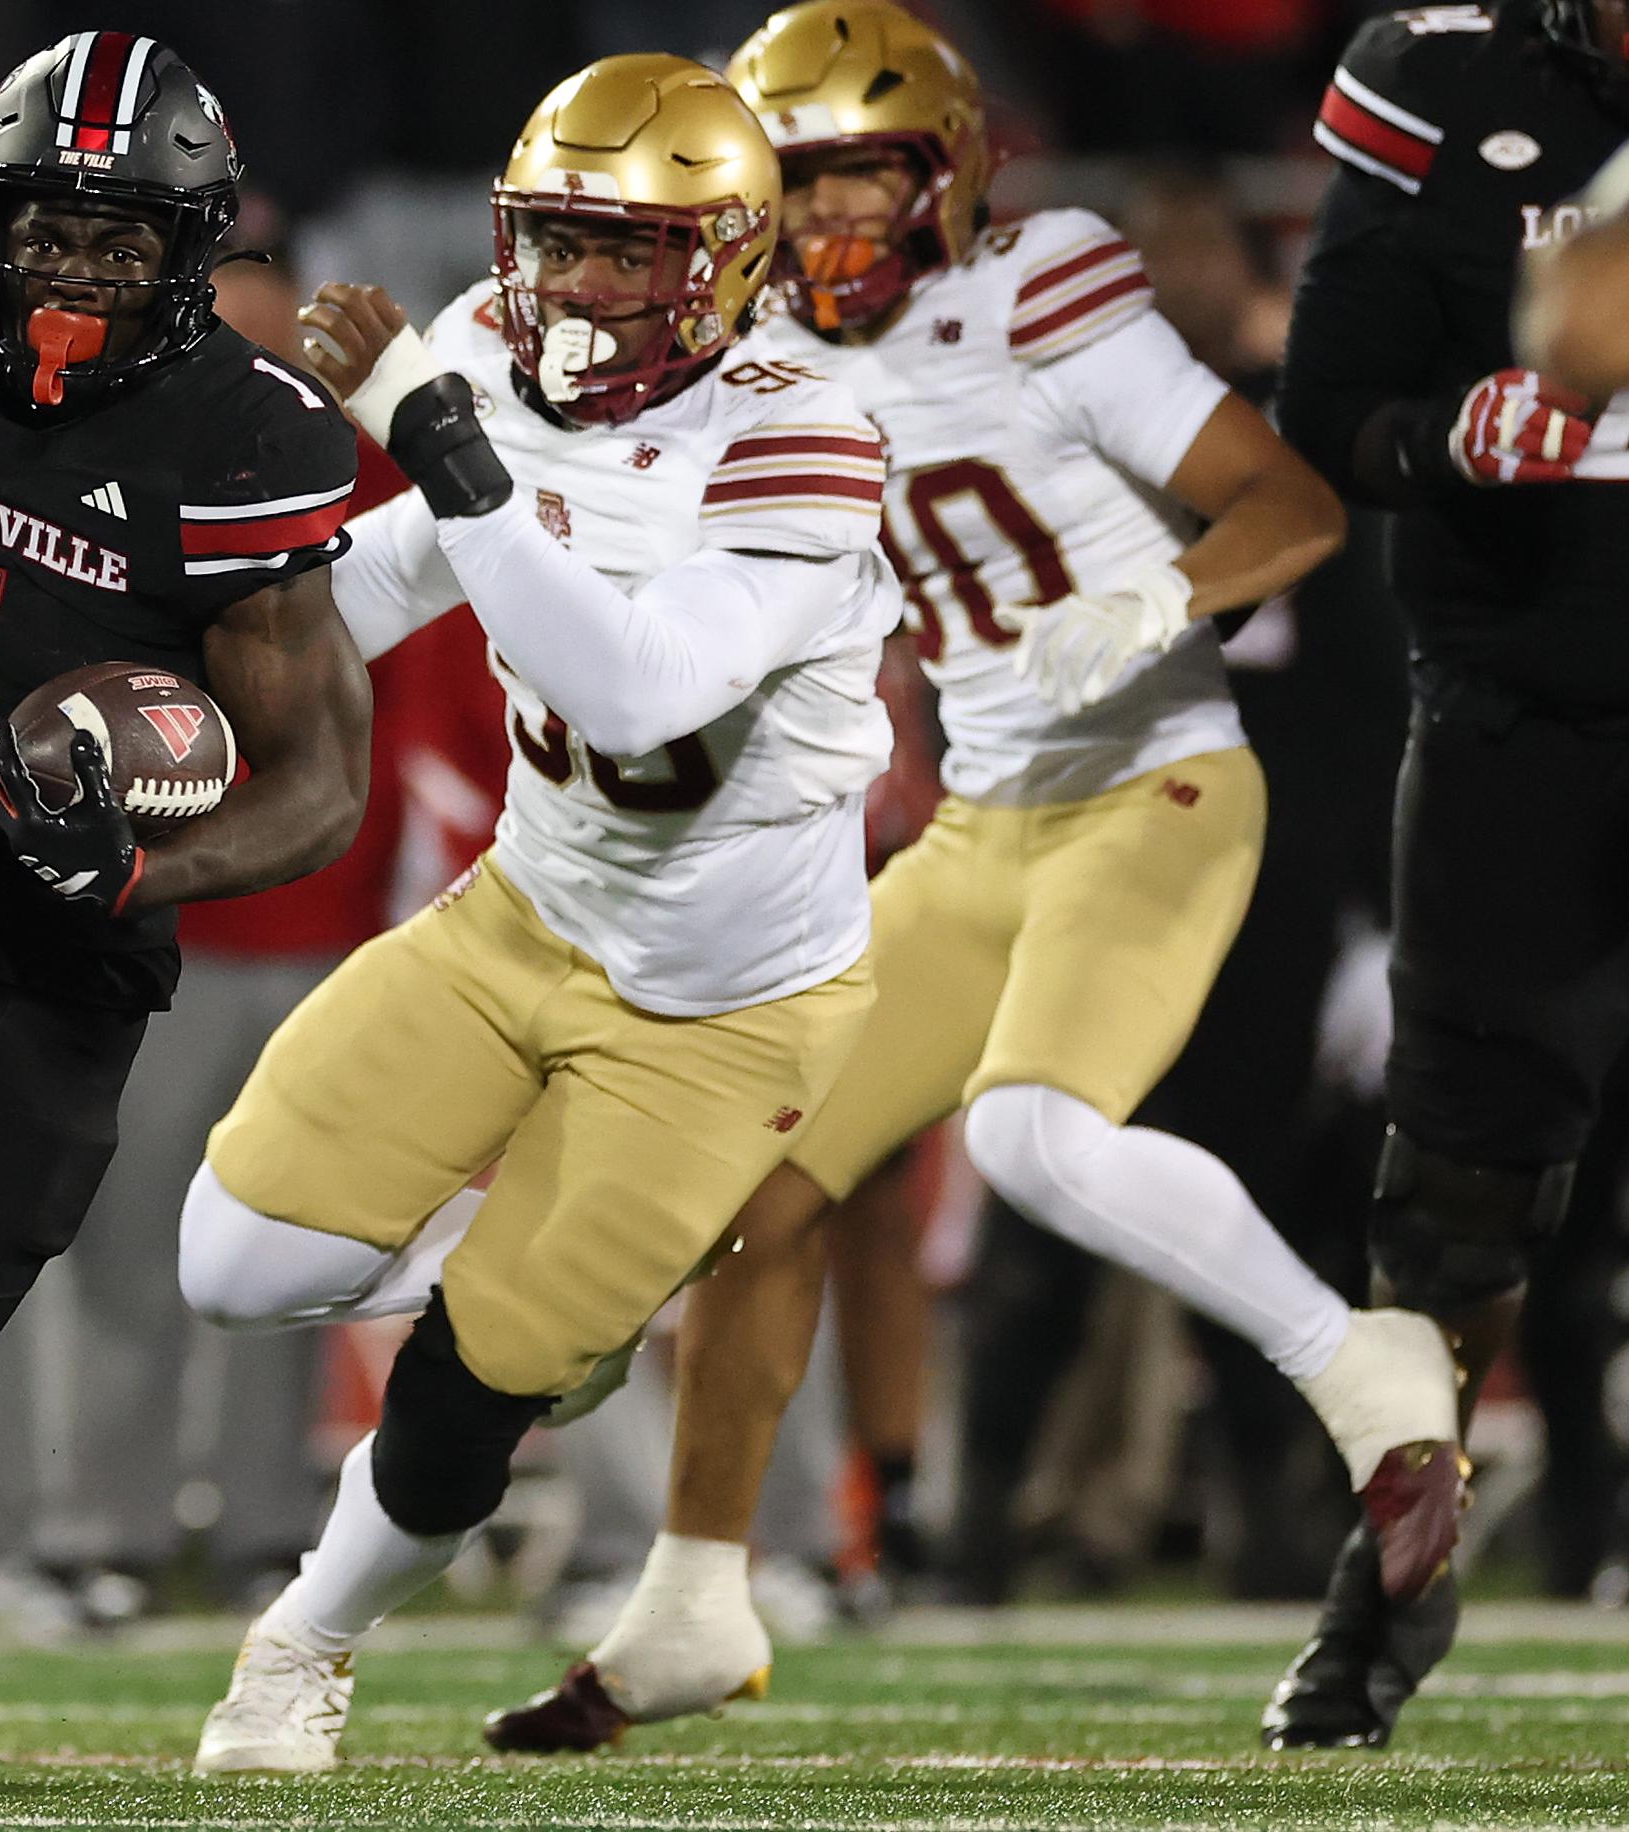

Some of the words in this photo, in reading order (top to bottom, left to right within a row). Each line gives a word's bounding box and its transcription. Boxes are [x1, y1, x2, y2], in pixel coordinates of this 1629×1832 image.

[58, 150, 82, 165] THE
[83, 153, 115, 170] VILLE
[253, 356, 326, 409] 1
